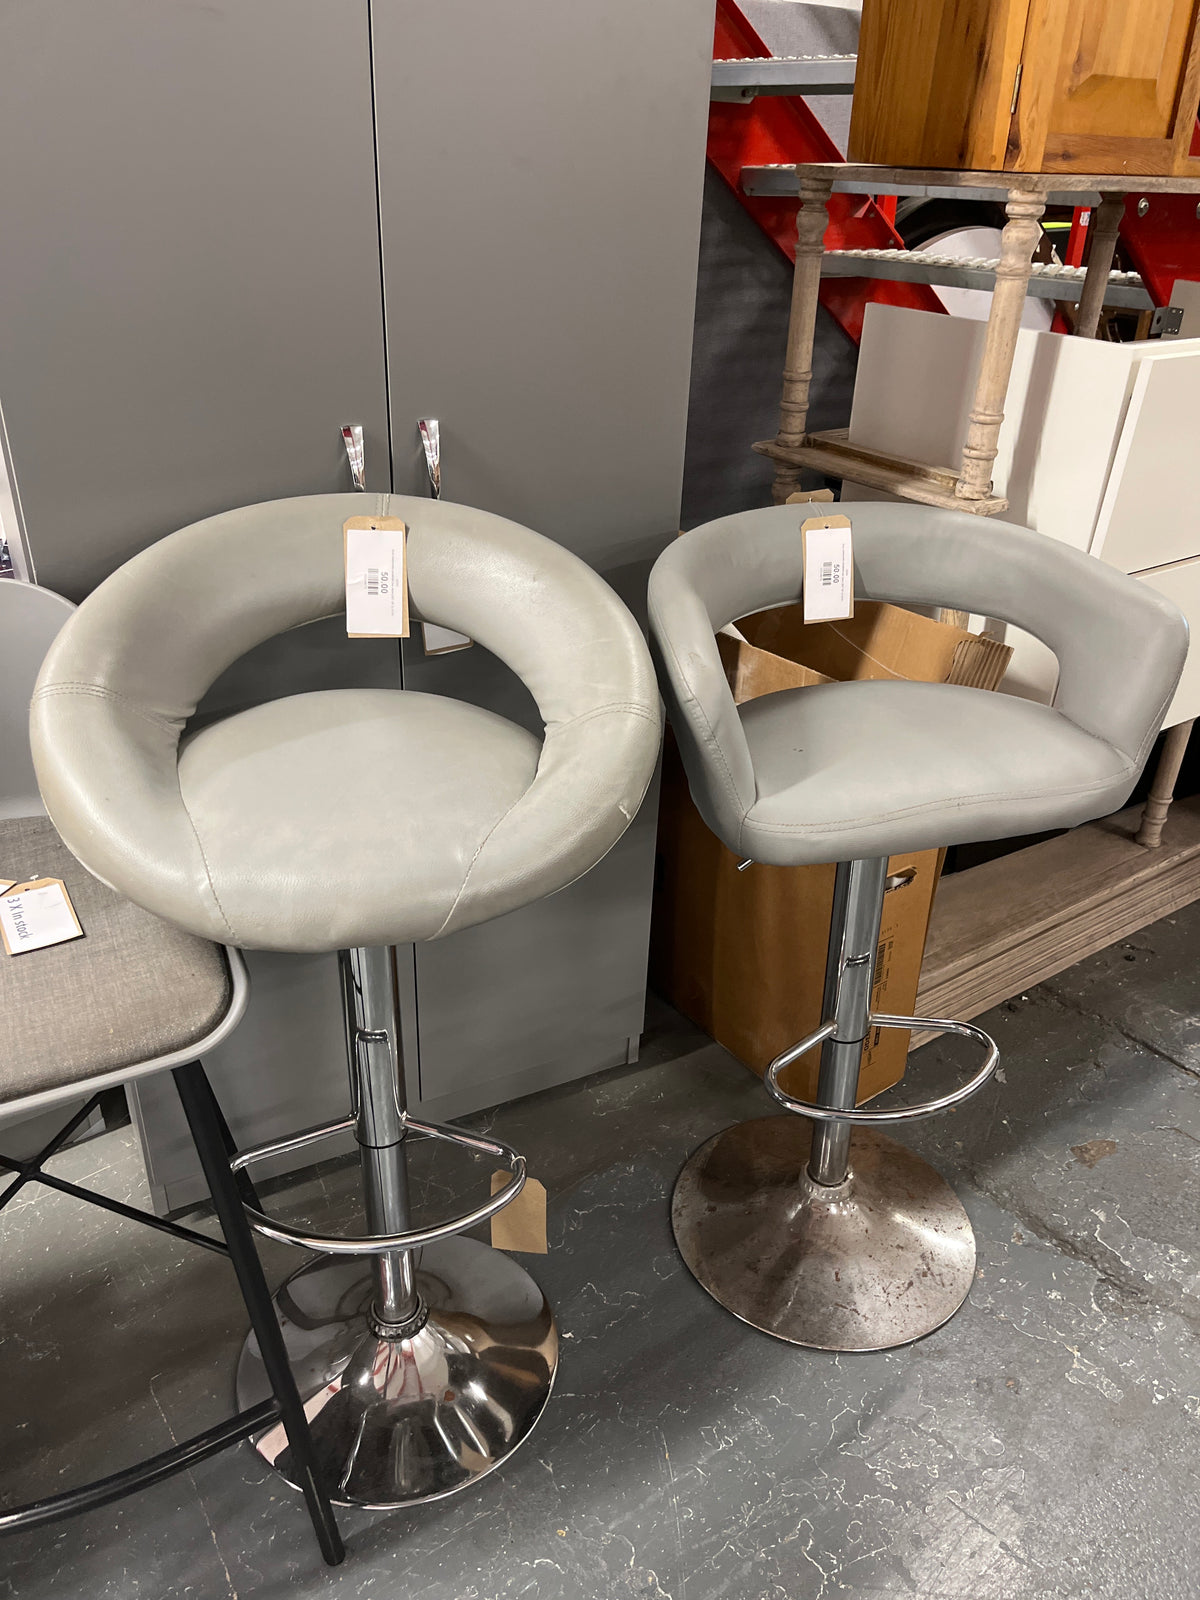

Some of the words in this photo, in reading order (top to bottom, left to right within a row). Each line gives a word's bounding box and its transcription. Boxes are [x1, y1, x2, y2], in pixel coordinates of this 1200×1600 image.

[380, 571, 389, 594] 50.00
[11, 910, 24, 921] In
[14, 920, 34, 940] stock
